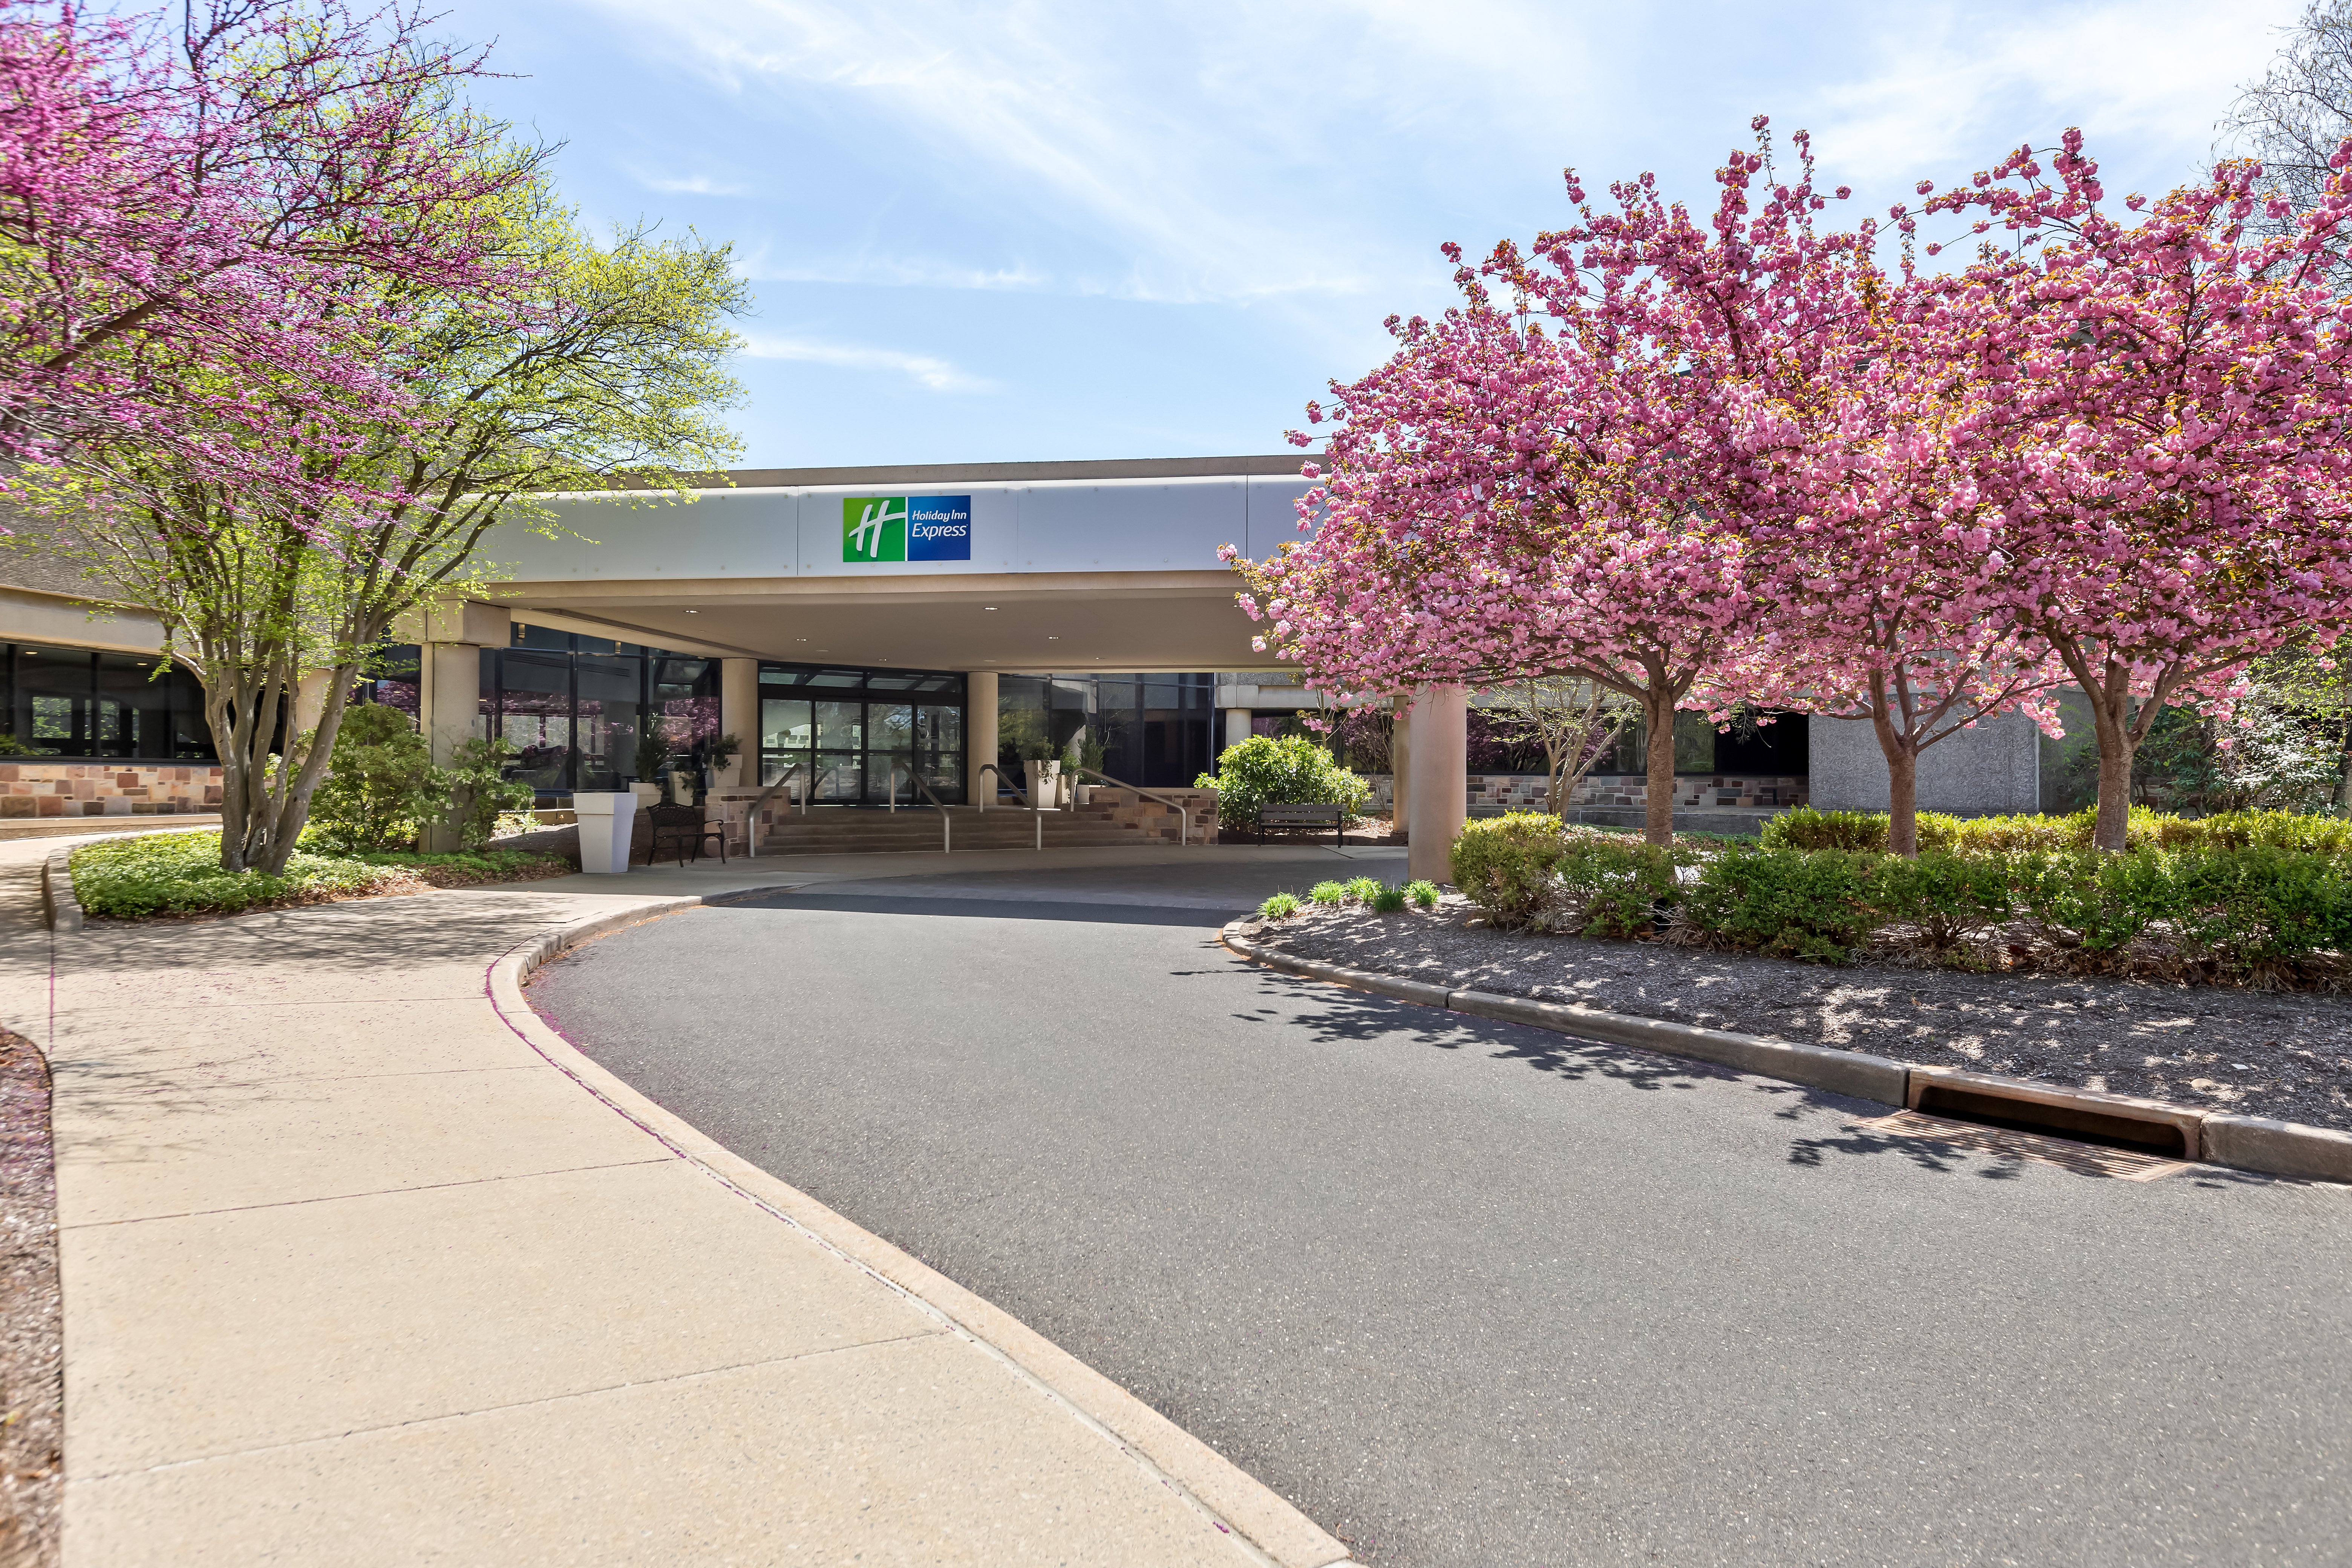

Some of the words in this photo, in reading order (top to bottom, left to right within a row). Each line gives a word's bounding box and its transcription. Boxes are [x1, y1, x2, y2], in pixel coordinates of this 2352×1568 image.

[912, 510, 950, 522] Holiday
[951, 510, 966, 520] Inn
[849, 500, 905, 557] H
[912, 523, 967, 541] Express
